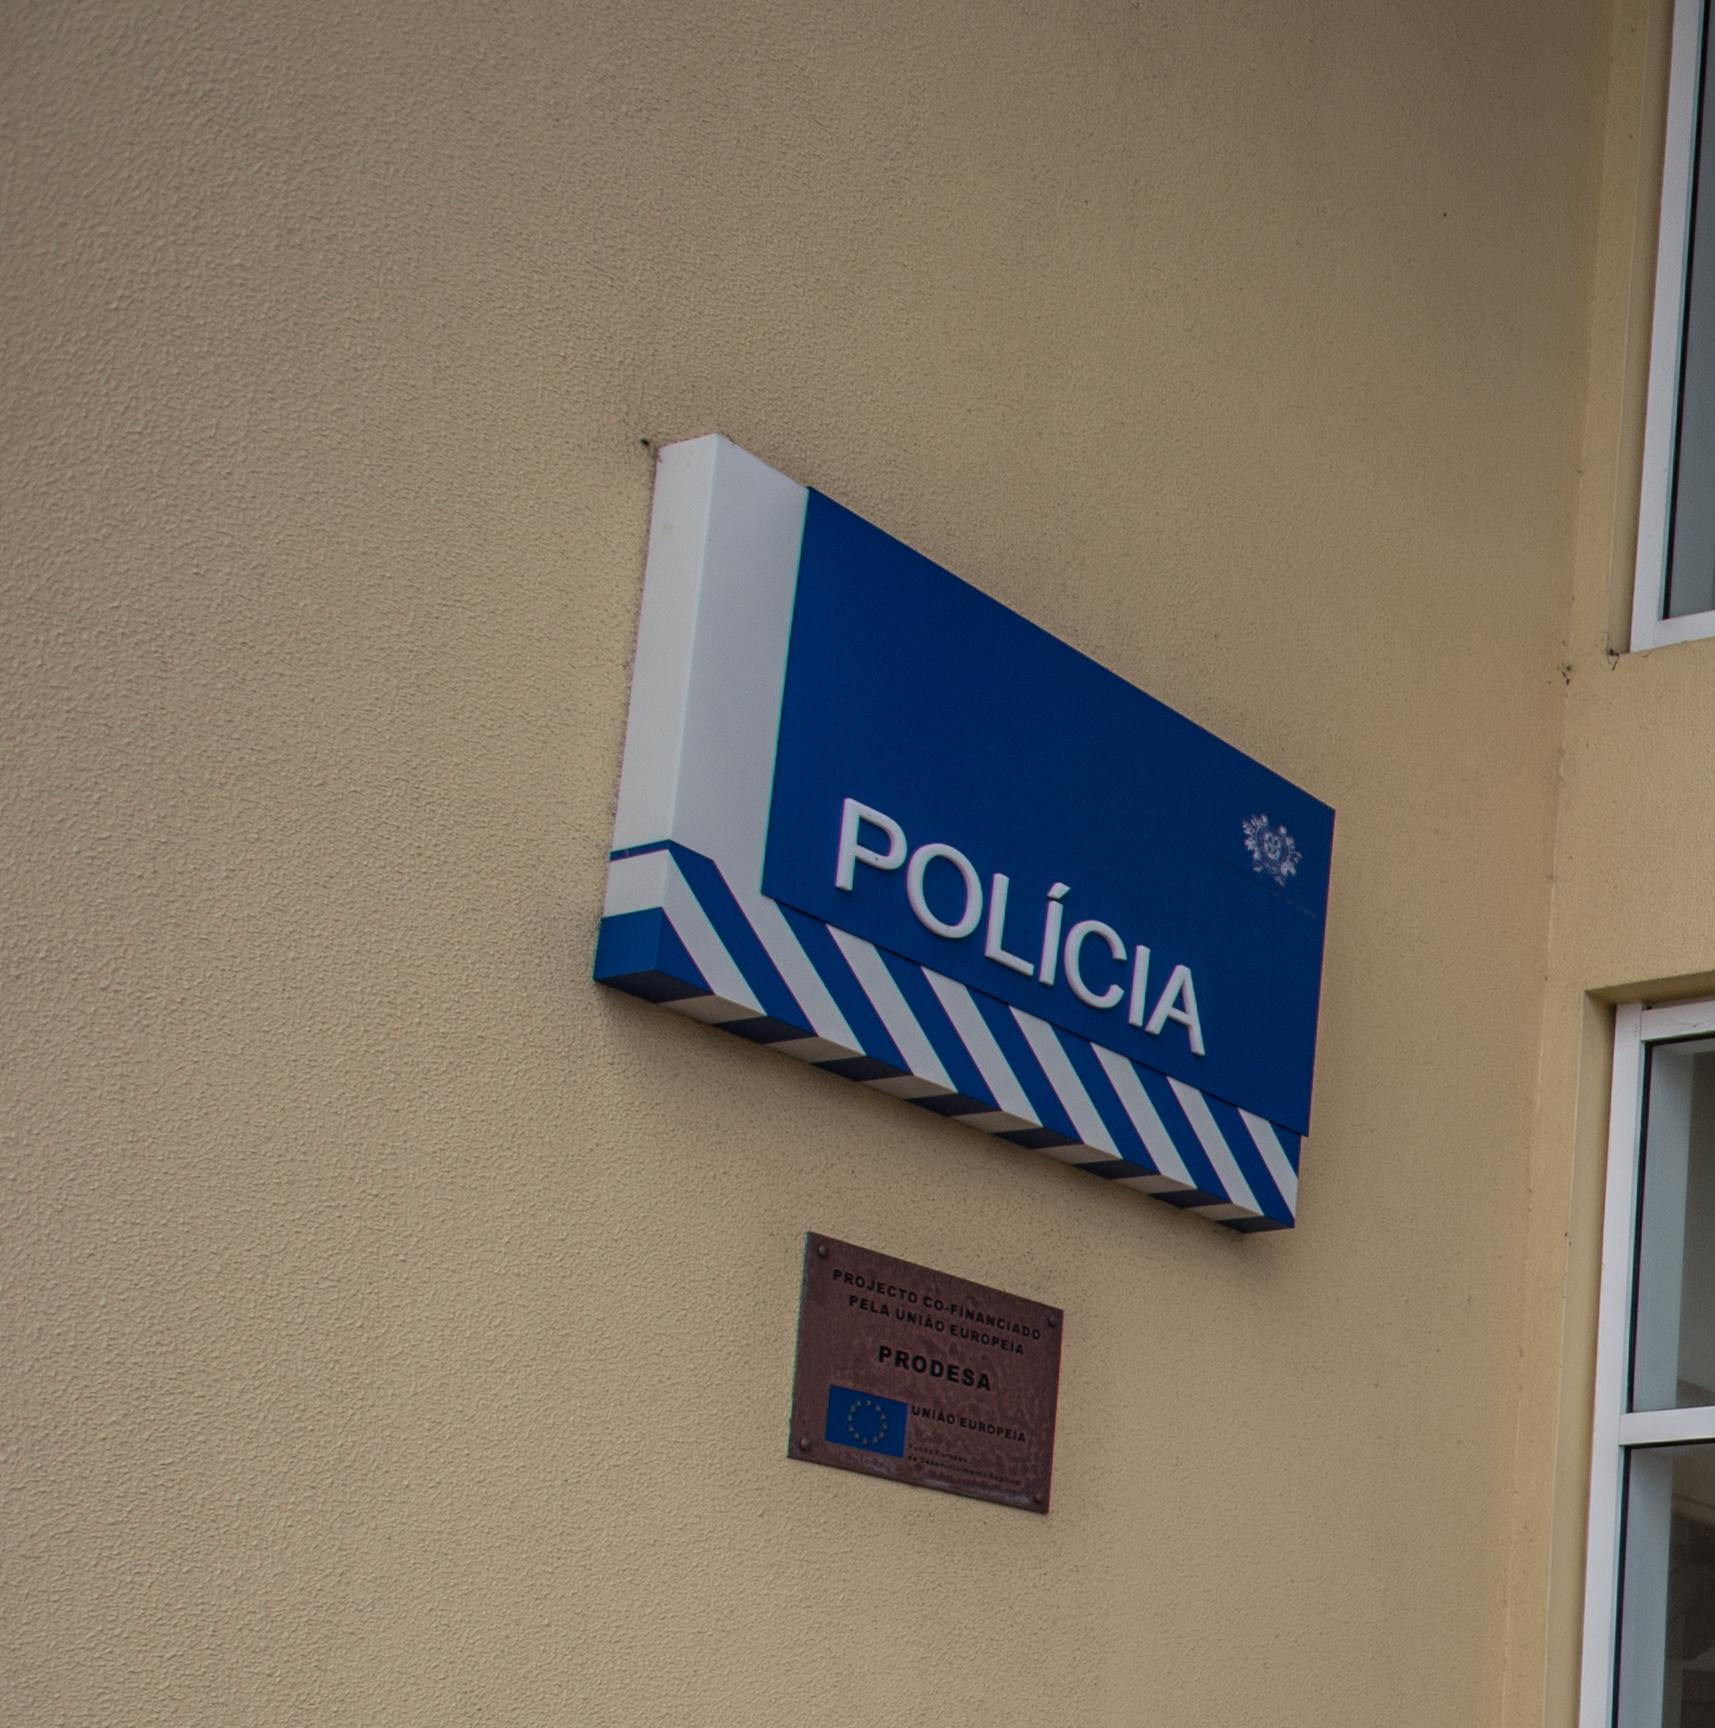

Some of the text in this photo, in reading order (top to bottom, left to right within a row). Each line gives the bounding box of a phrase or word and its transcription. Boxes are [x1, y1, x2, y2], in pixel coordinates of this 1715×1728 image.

[835, 797, 1206, 1057] POLÍCIA
[832, 1268, 1041, 1341] PROJECTO CO-FINANCIADO
[848, 1295, 1025, 1356] PELA UNIÃO EUROPEIA
[877, 1345, 991, 1392] PRODESA
[960, 1417, 1026, 1443] EUROPEIA
